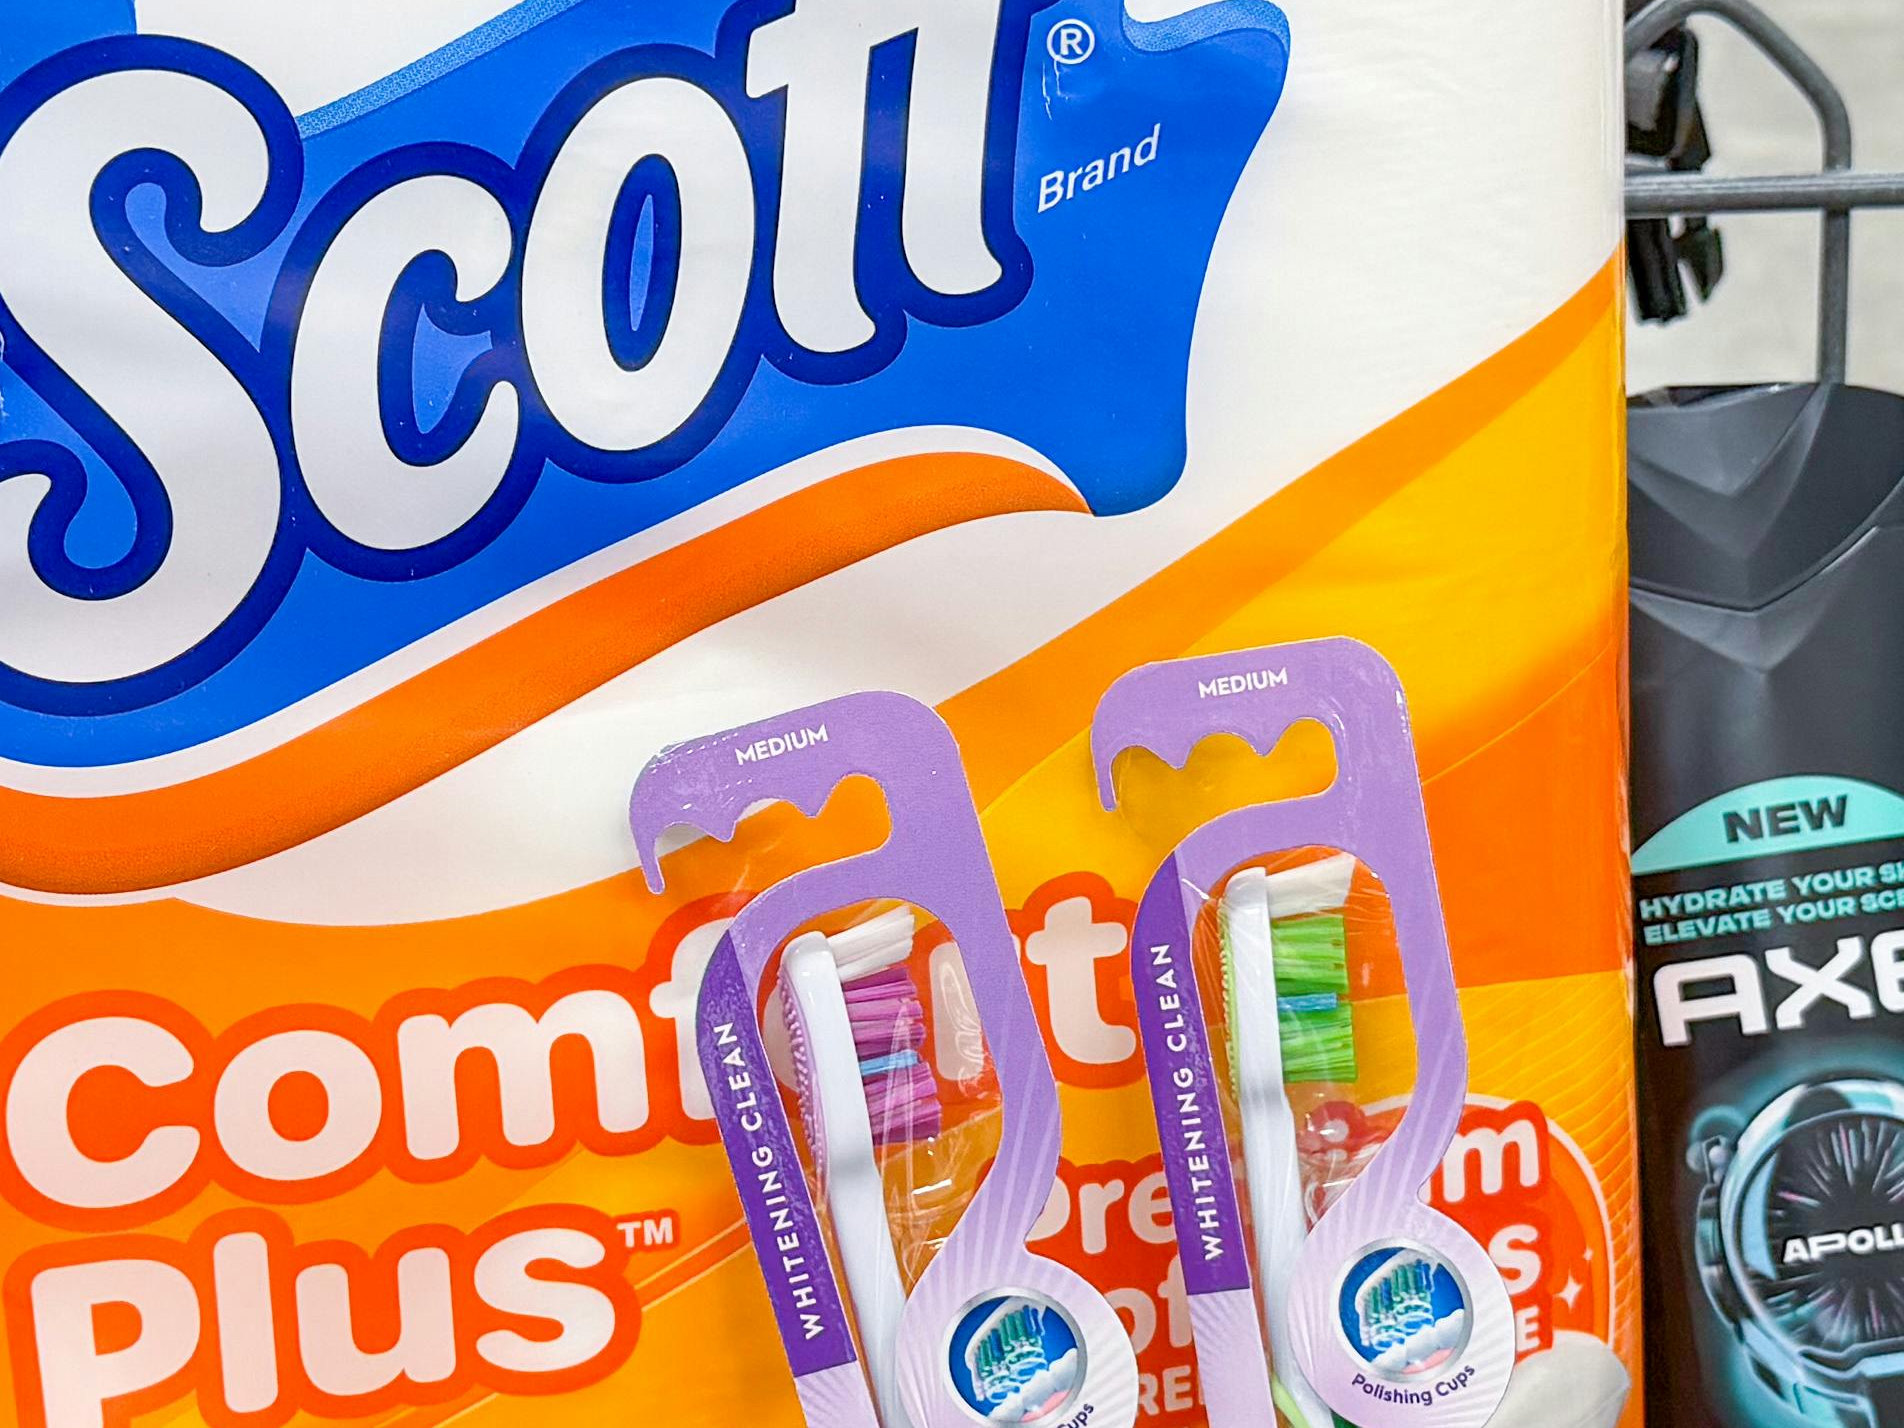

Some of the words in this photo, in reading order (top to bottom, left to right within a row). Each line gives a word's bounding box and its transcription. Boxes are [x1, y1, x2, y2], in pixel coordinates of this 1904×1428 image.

[1036, 123, 1162, 214] Brand
[1198, 667, 1288, 698] MEDIUM
[734, 724, 829, 766] MEDIUM
[1723, 794, 1849, 843] NEW
[1639, 878, 1787, 921] HYDRATE
[1791, 868, 1876, 896] YOUR
[1643, 908, 1773, 946] ELEVATE
[1776, 897, 1858, 925] YOUR
[1150, 943, 1187, 1052] CLEAN
[714, 1021, 763, 1131] CLEAN
[1173, 1067, 1225, 1261] WHITENING
[752, 1145, 825, 1341] WHITENING
[1351, 1373, 1433, 1406] Polishing
[1435, 1363, 1475, 1397] Cups
